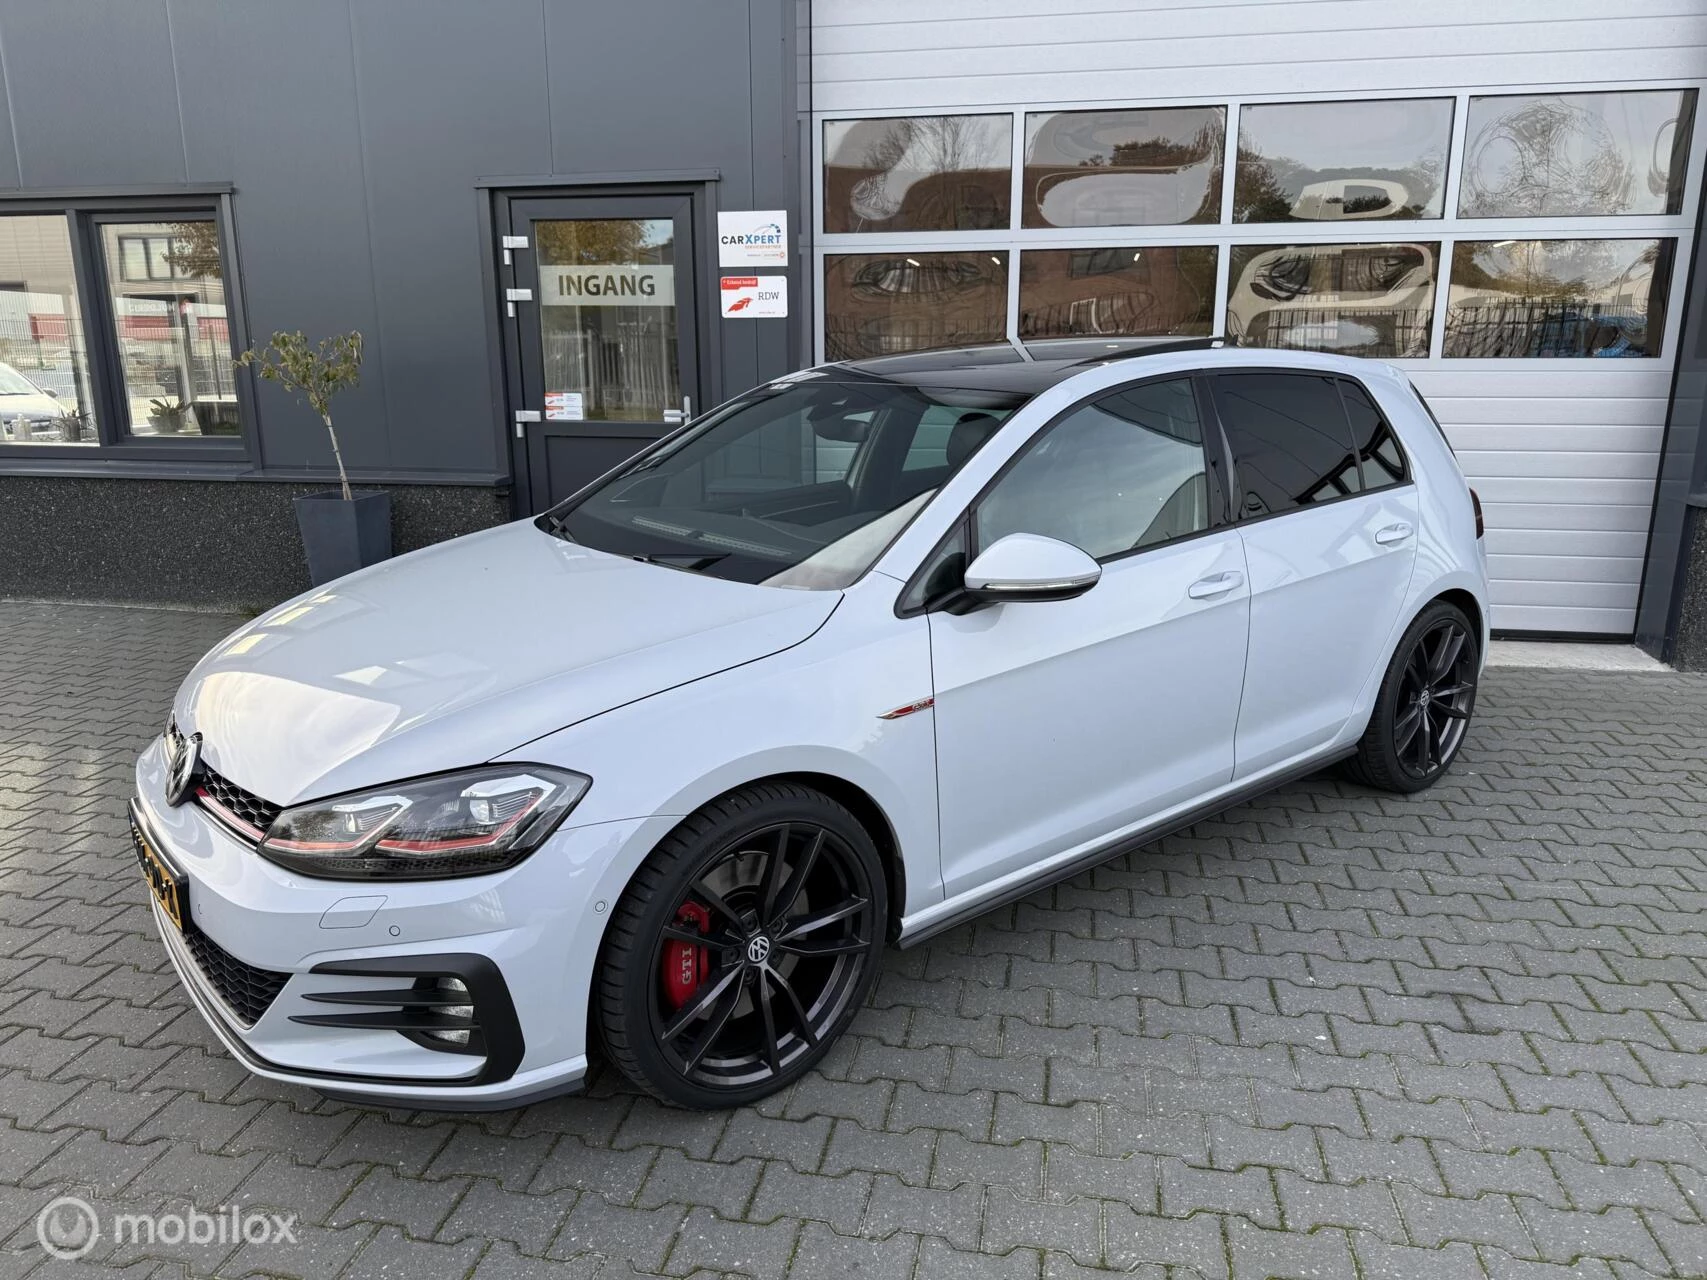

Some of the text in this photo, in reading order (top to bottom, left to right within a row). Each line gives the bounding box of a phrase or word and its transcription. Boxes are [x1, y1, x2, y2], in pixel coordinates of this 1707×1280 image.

[721, 234, 782, 245] CARXPERT
[558, 274, 656, 297] INGANG
[757, 291, 780, 301] RDW
[682, 948, 692, 985] GTI
